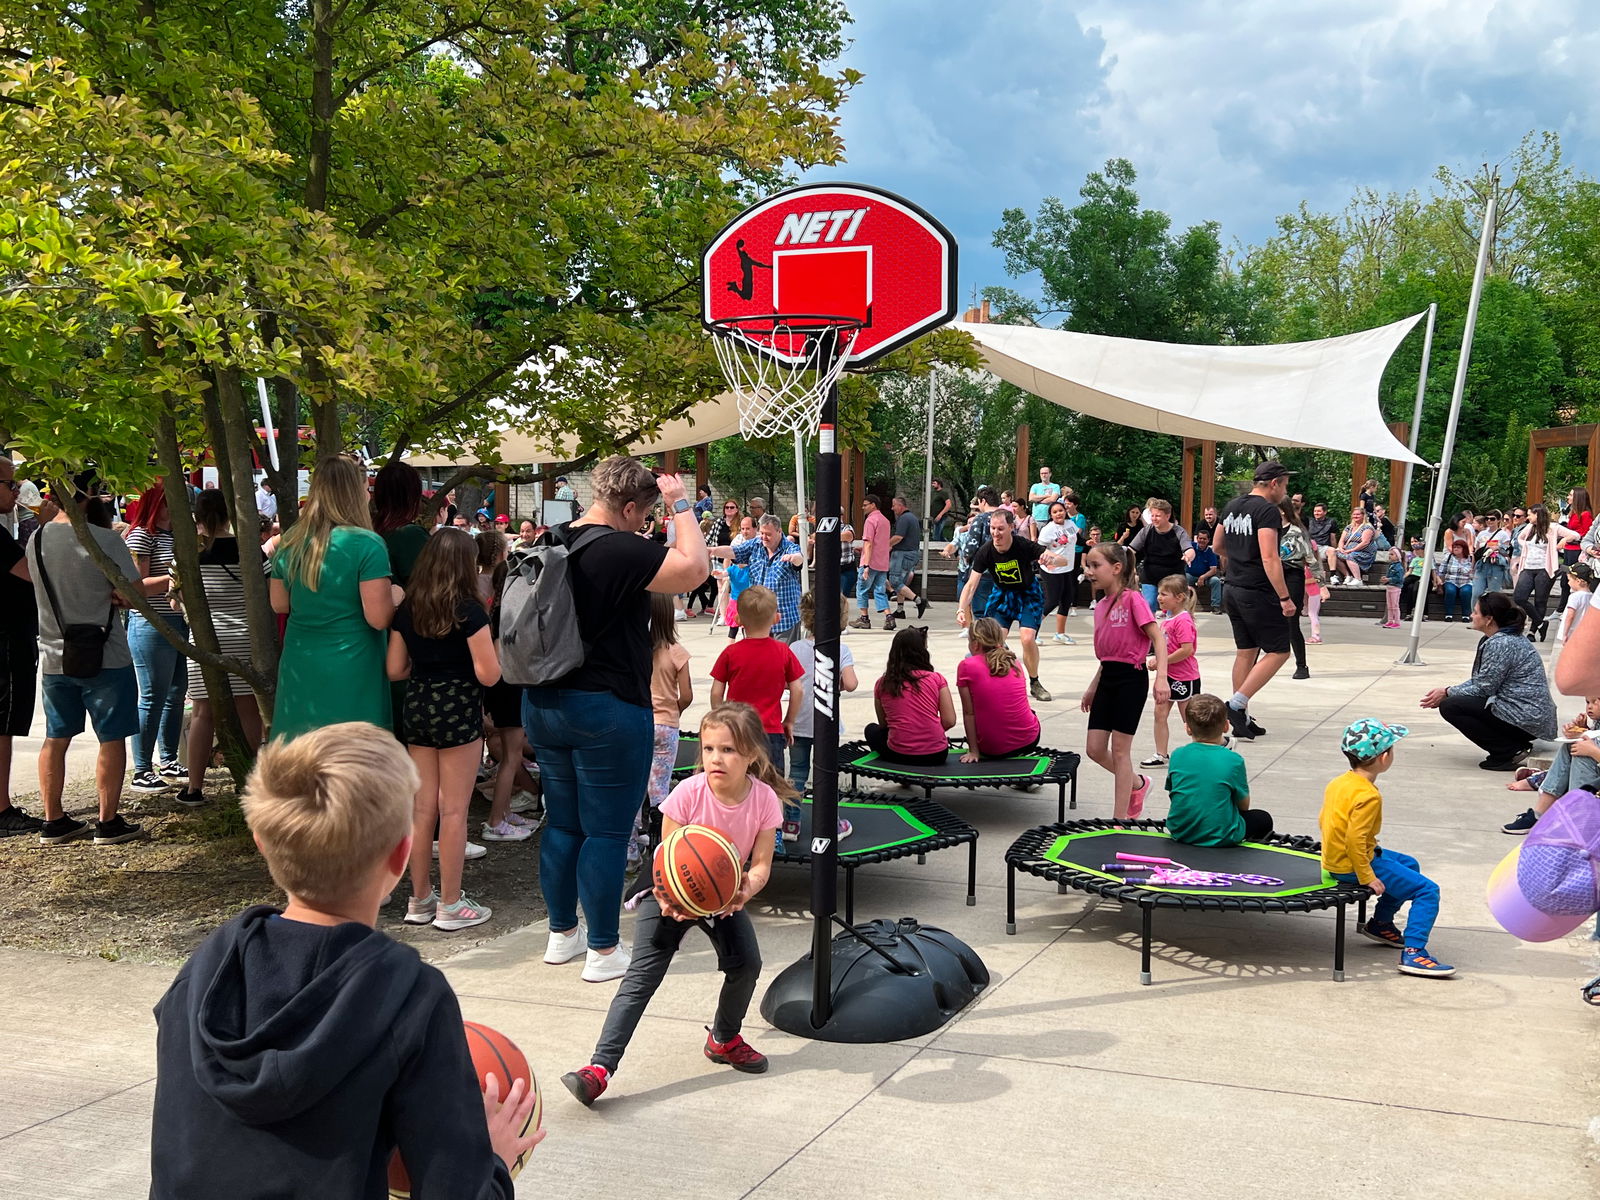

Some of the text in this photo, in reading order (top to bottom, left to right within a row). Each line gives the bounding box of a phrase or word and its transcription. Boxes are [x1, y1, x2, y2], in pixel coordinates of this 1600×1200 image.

[817, 517, 838, 532] N
[811, 837, 831, 854] N
[681, 864, 706, 902] CHICAGO
